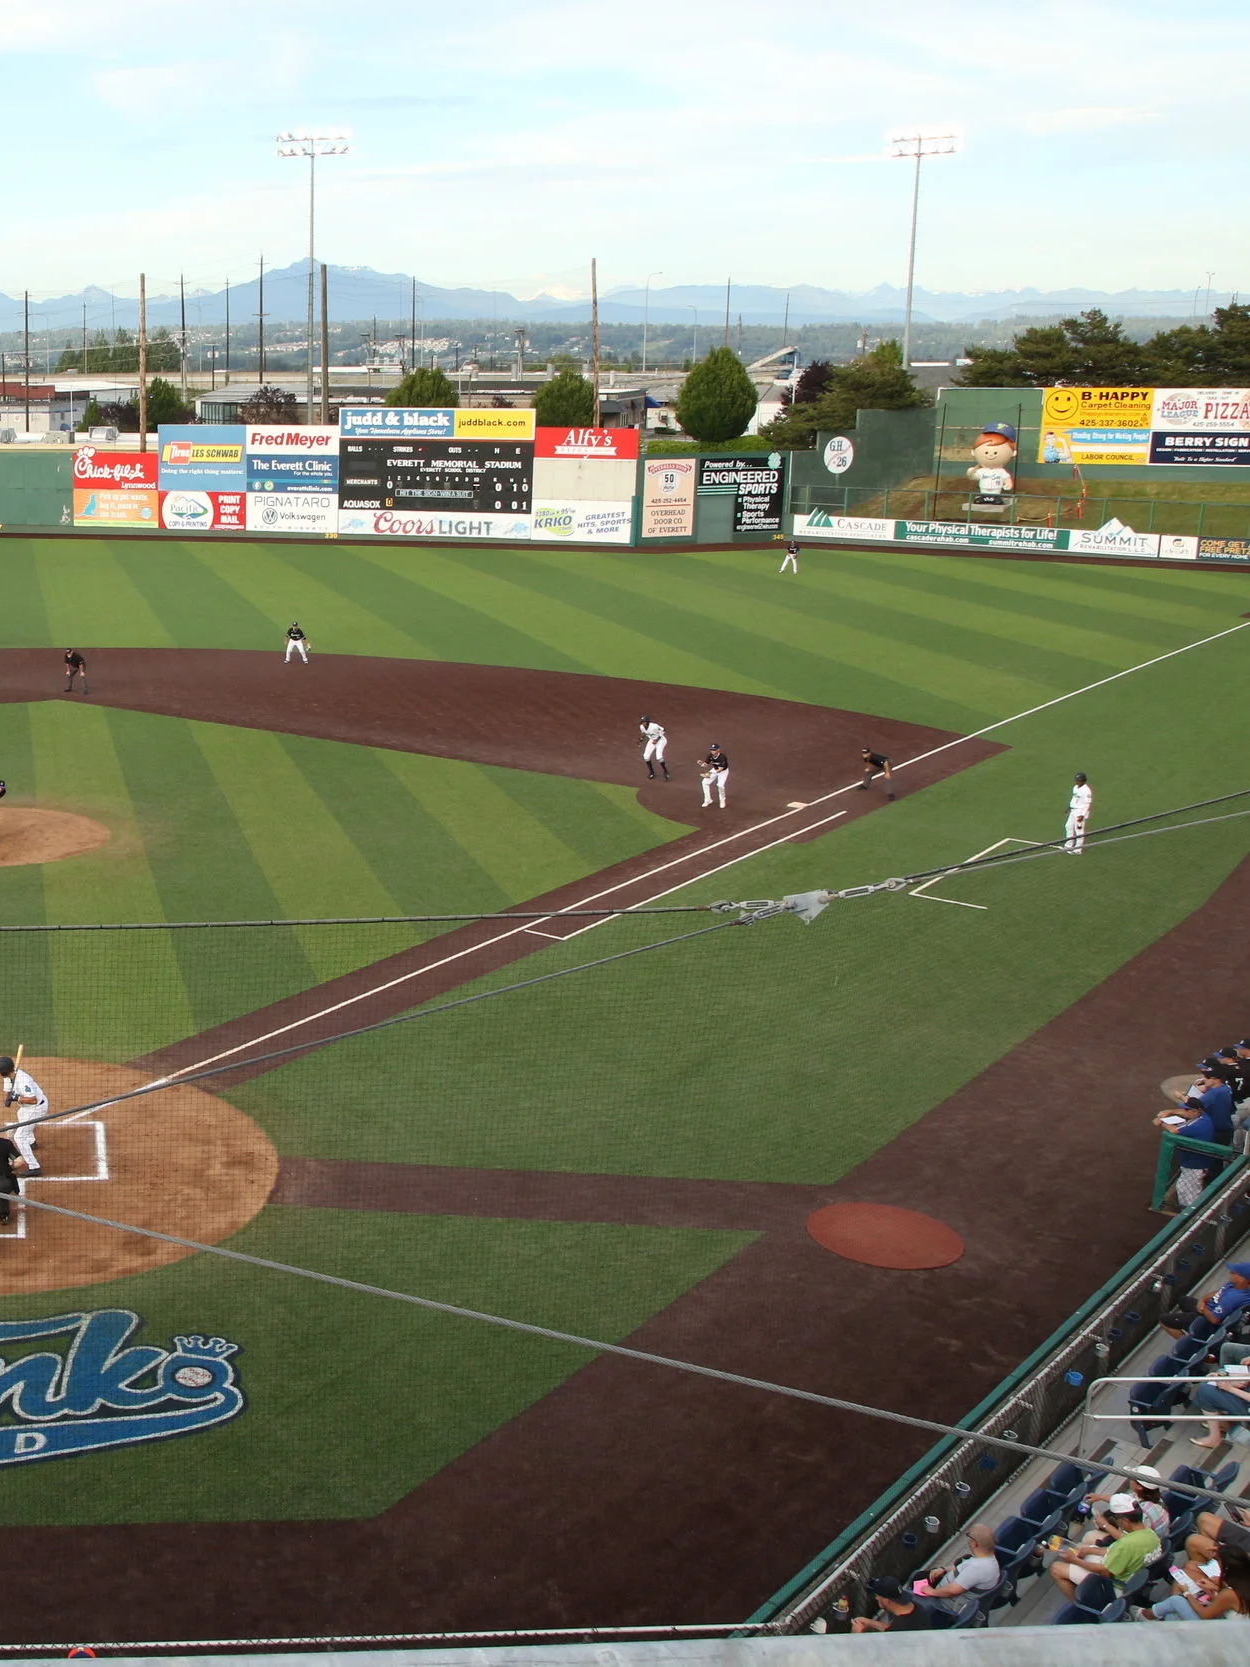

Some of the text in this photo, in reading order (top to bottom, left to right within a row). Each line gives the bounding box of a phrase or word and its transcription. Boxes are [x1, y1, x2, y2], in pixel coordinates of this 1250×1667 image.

[1114, 402, 1150, 410] Cleaning
[1162, 401, 1197, 410] MAJOR
[1204, 403, 1250, 419] PIZZA
[1161, 410, 1198, 418] LEAGUE
[344, 412, 450, 429] judd & black
[459, 419, 525, 428] juddblack.com
[251, 433, 331, 448] Fred Meyer
[562, 429, 612, 447] Alfy's
[1165, 437, 1249, 446] BERRY SIGN
[171, 445, 238, 460] Tires LES SCHWAB
[74, 454, 145, 481] Chick-fil-A
[252, 460, 332, 471] The Everett Clinic
[431, 460, 479, 468] MEMORIAL
[485, 461, 521, 469] STADIUM
[665, 474, 674, 482] 50
[703, 471, 778, 484] ENGINEERED
[387, 481, 393, 489] 0
[495, 483, 502, 492] 0
[513, 483, 517, 492] 1
[522, 483, 528, 492] 0
[739, 483, 778, 494] SPORTS
[254, 496, 330, 507] PIGNATARO
[343, 500, 380, 508] AQUASOX
[495, 501, 501, 509] 0
[512, 501, 517, 509] 0
[522, 501, 527, 510] 1
[743, 496, 770, 504] Physical
[171, 504, 200, 512] Pacific
[280, 512, 325, 522] Volkswagen
[586, 512, 626, 520] GREATEST
[374, 512, 492, 535] Coors LIGHT
[534, 516, 572, 528] KRKO
[838, 519, 886, 531] CASCADE
[906, 522, 1057, 540] Your Physical Therapists for Life!
[906, 535, 1053, 548] cascaderehab.com summitrehab.com
[1082, 533, 1147, 546] SUMMIT
